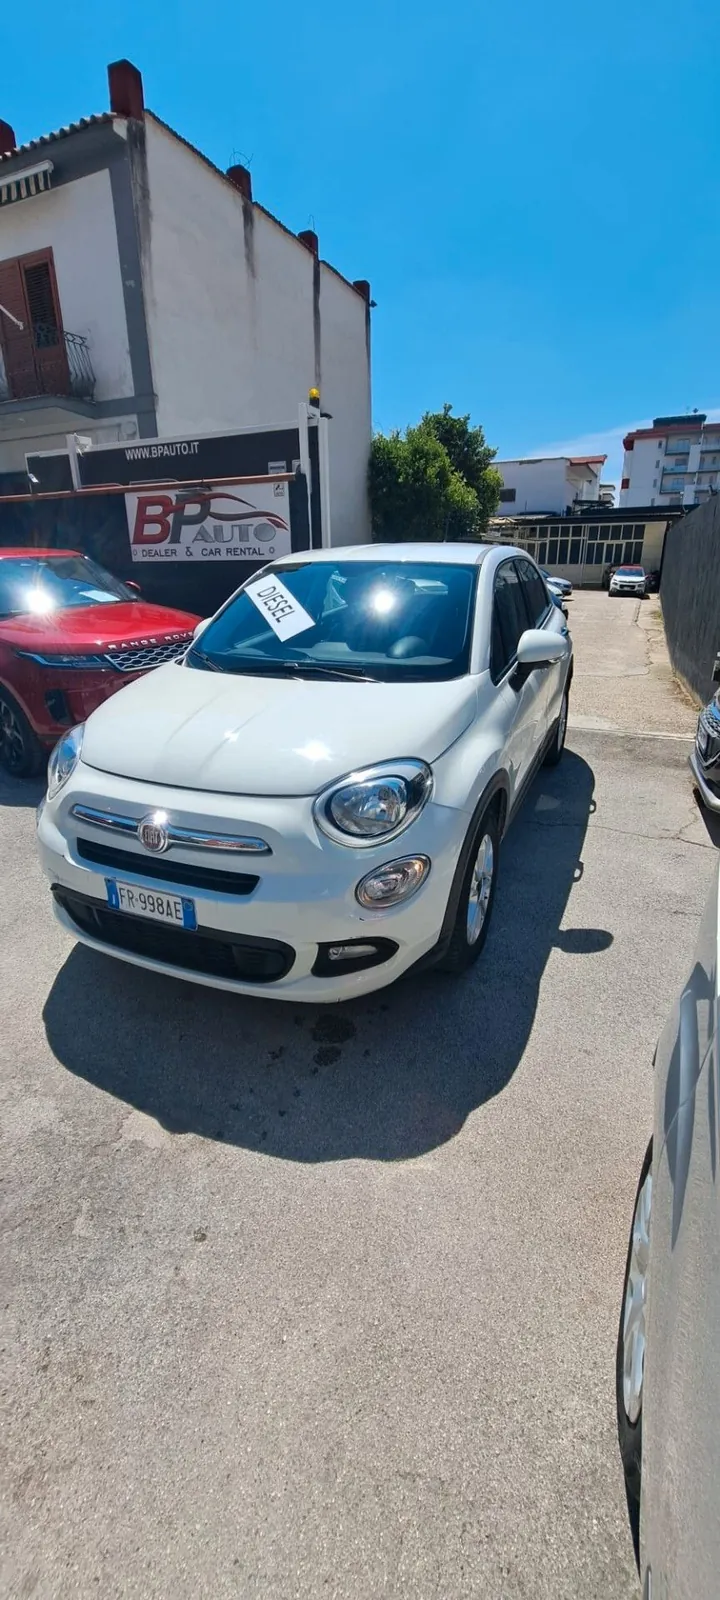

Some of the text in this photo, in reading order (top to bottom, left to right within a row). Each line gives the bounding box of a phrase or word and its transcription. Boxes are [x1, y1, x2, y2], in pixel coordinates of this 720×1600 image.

[125, 442, 199, 460] WWW.BPAUTO.IT
[132, 493, 211, 545] BP
[192, 523, 276, 543] AUTO
[142, 546, 264, 557] DEALER & CAR RENTAL
[257, 585, 295, 623] DIESEL
[107, 631, 194, 650] RANGE ROVE
[144, 829, 159, 845] FIAT
